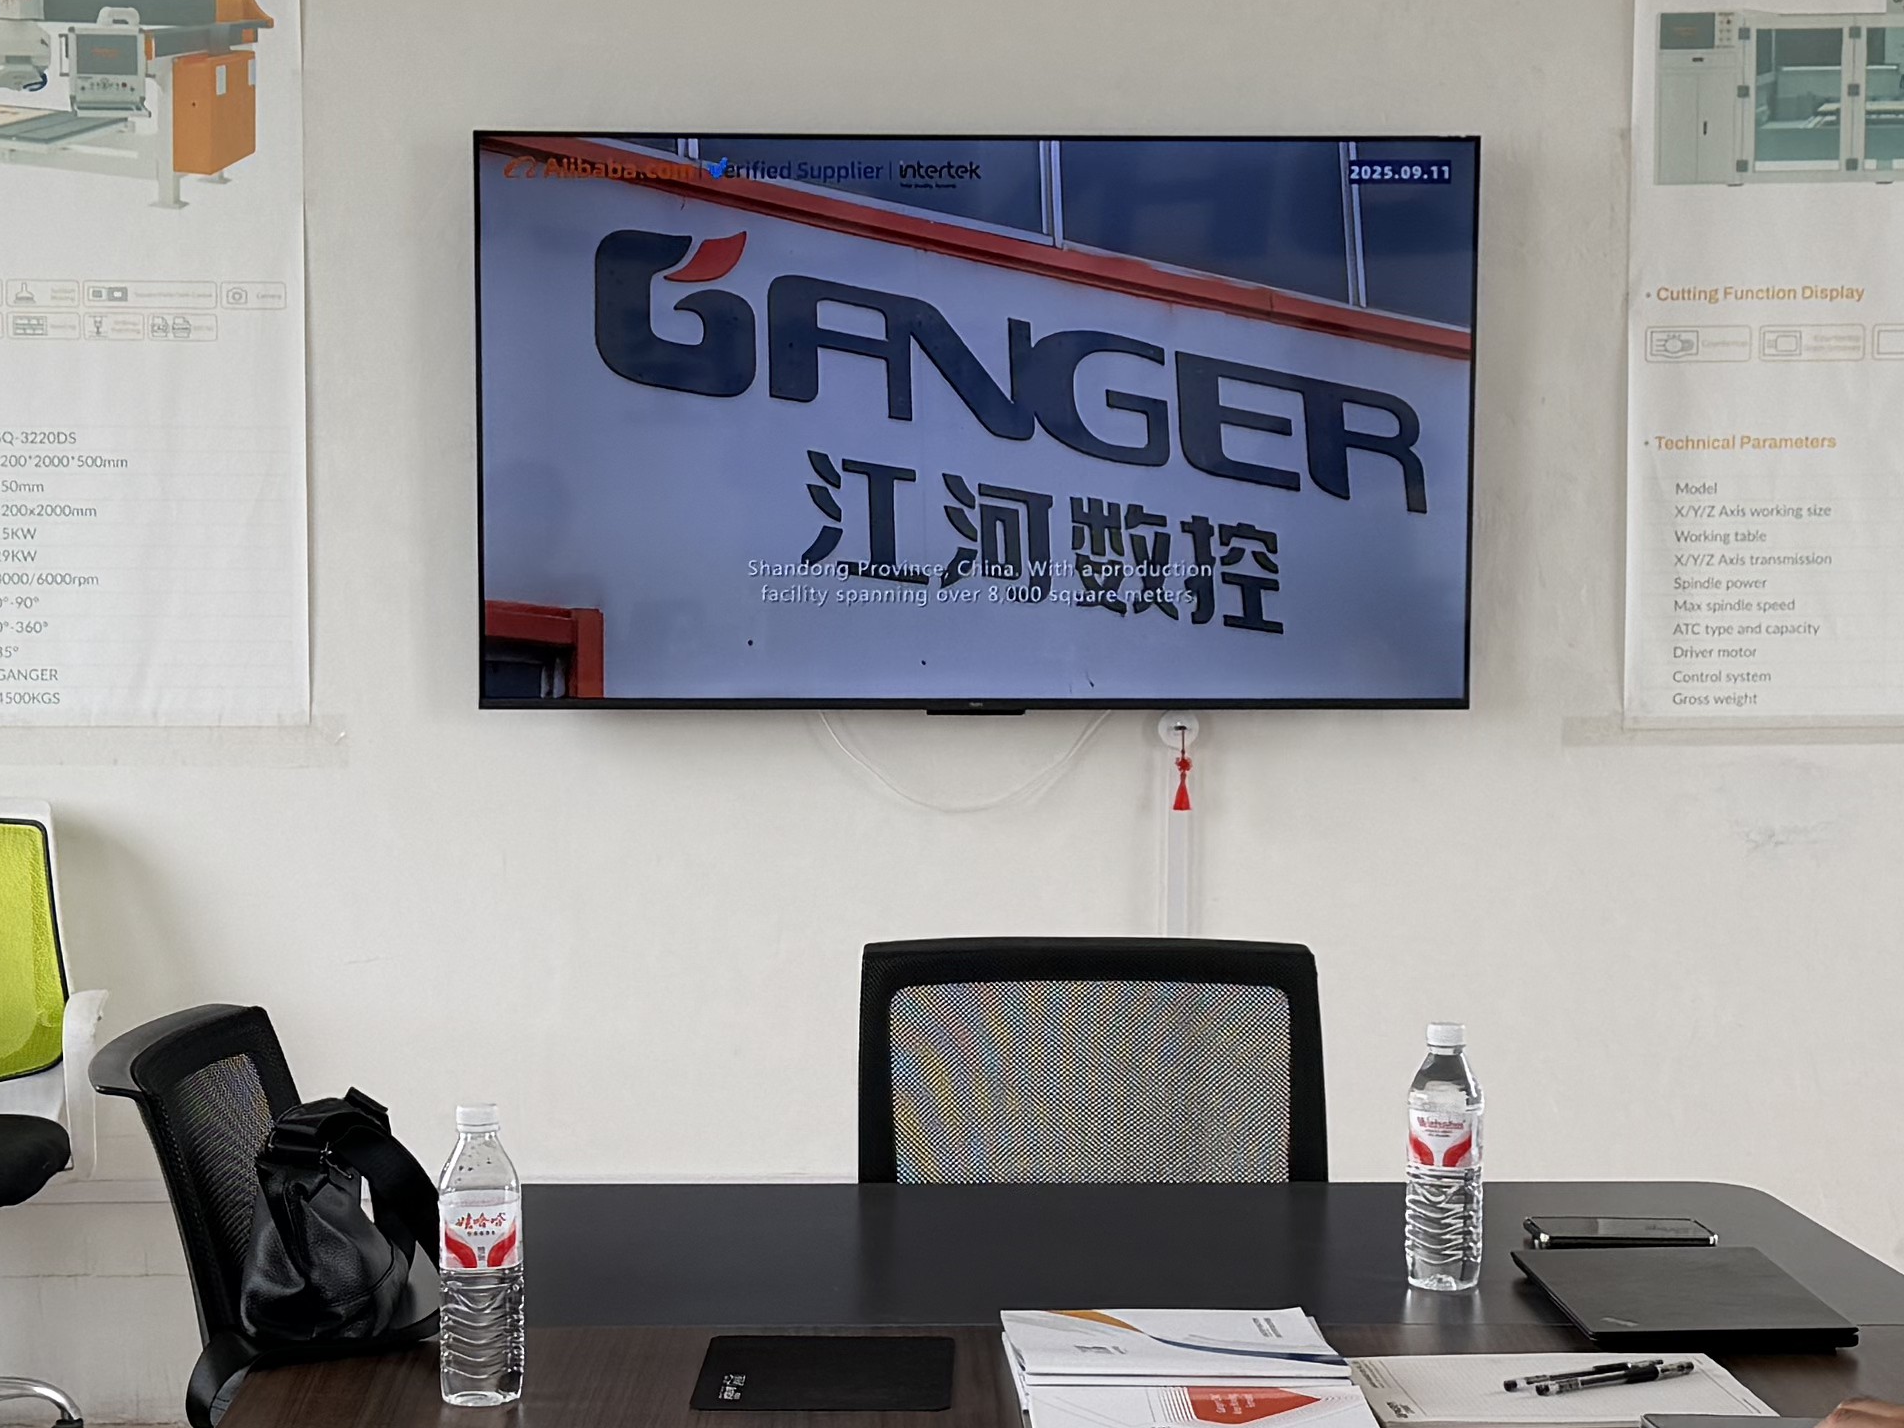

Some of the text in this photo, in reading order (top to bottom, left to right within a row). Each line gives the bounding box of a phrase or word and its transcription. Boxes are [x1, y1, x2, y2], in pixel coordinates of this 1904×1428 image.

[797, 161, 884, 185] Supplier
[899, 160, 982, 180] intertek
[1350, 165, 1449, 180] 2025.09.11
[1656, 285, 1865, 304] Cutting Function Display
[593, 228, 1428, 514] GANGER
[1655, 434, 1837, 451] Technical Parameters
[1675, 482, 1718, 496] Model
[1674, 504, 1832, 519] X/Y/Z Axis working size
[800, 448, 1284, 636] 江河数控
[1674, 529, 1768, 545] Working table
[1674, 552, 1833, 567] X/Y/Z Axis transmission
[747, 558, 850, 581] Shandong
[957, 559, 1020, 579] China.
[1027, 559, 1075, 579] With
[1082, 564, 1094, 579] a
[1099, 559, 1213, 583] production
[1673, 576, 1767, 592] Spindle power
[760, 583, 829, 606] facility
[835, 585, 929, 607] spanning
[936, 588, 981, 604] over
[987, 585, 1043, 605] 8,000
[1049, 588, 1117, 607] square
[1673, 598, 1796, 614] Max spindle speed
[1672, 622, 1820, 637] ATC type and capacity
[1672, 646, 1757, 659] Driver motor
[1672, 670, 1772, 684] Control system
[1672, 692, 1758, 708] Gross weight
